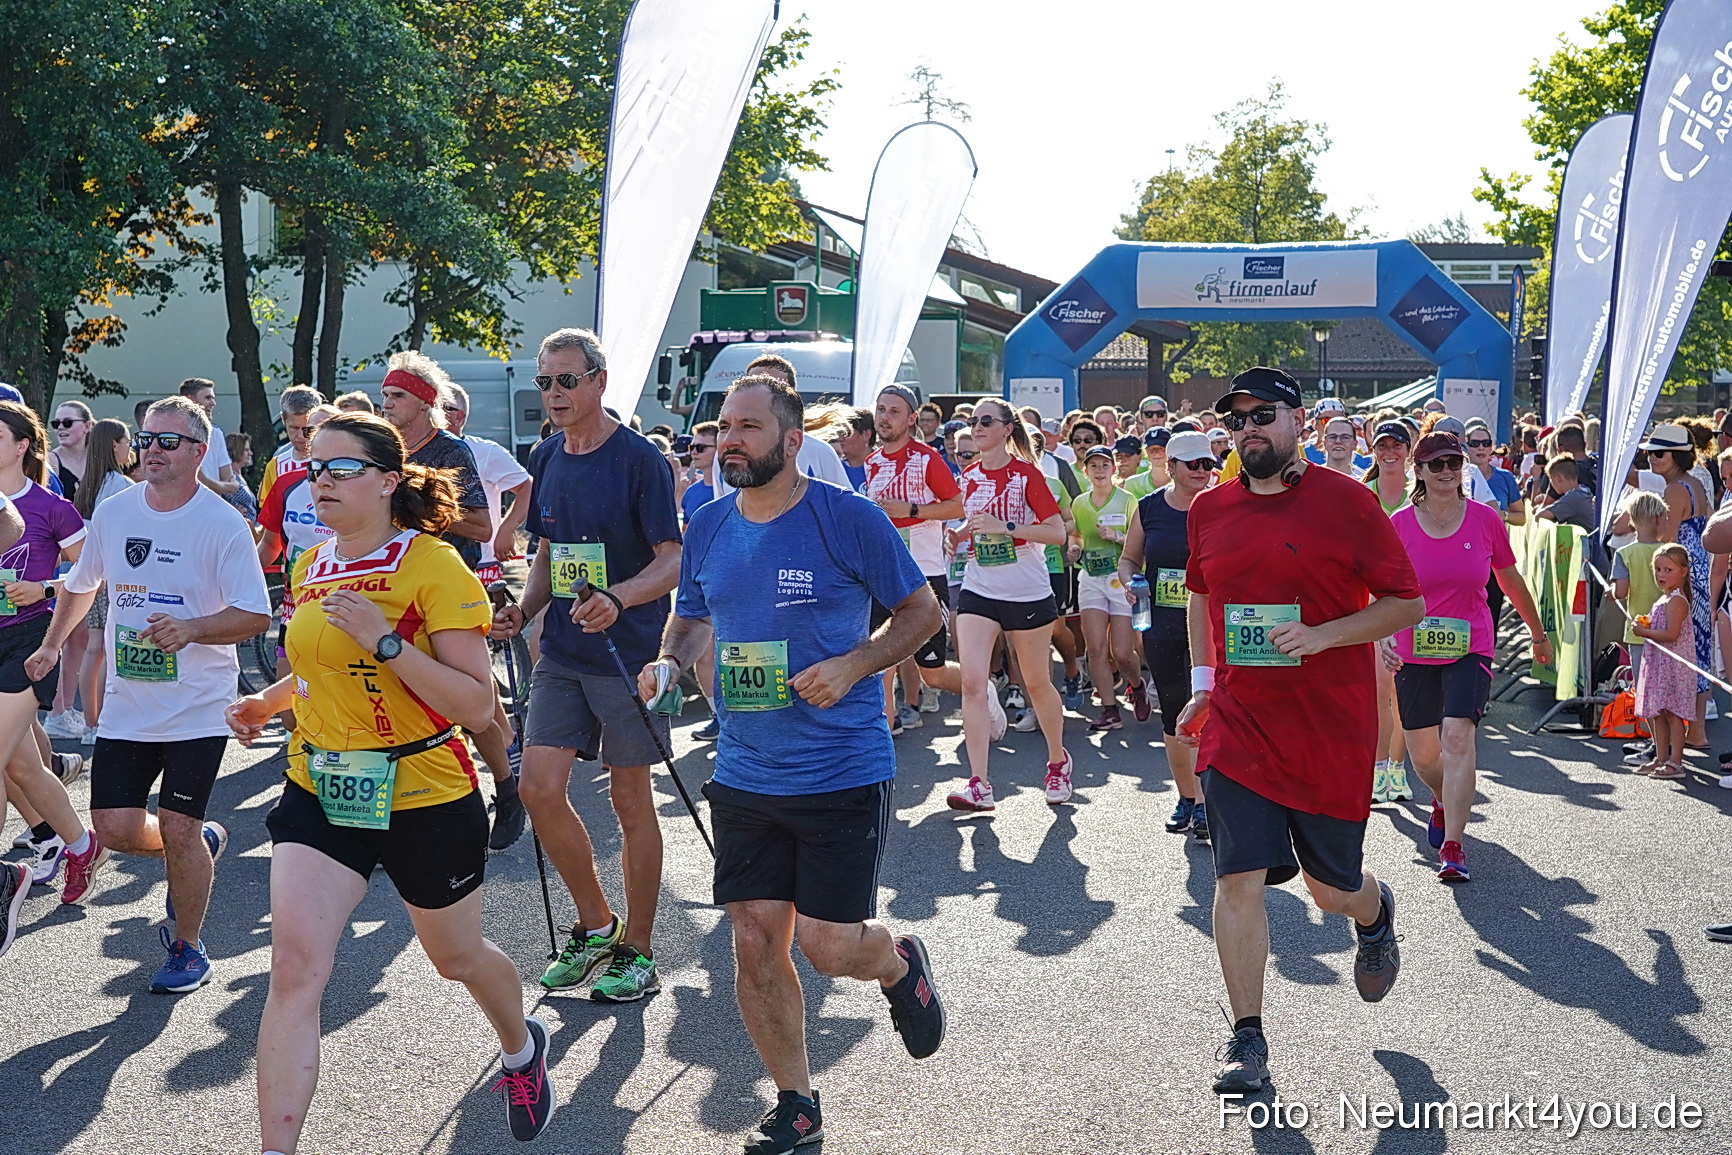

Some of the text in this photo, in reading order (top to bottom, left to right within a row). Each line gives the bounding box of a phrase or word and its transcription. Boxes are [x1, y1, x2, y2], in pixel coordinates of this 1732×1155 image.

[1590, 141, 1629, 243] Fisch
[1229, 279, 1318, 296] firmenlauf
[1057, 307, 1107, 319] Fischer
[1061, 317, 1102, 325] AUTOMOBILE
[154, 547, 181, 557] Autohaus
[978, 542, 1007, 556] 1125
[156, 556, 176, 564] Müller
[1091, 557, 1110, 568] 935
[559, 562, 589, 580] 496
[778, 568, 814, 583] DESS
[115, 584, 147, 594] GLAS
[777, 580, 813, 589] Transporte
[777, 587, 813, 596] Logistik
[116, 592, 146, 611] Götz
[1426, 630, 1456, 646] 899
[122, 645, 165, 666] 1226
[1238, 647, 1258, 655] Ferstl
[728, 666, 766, 689] 140
[774, 668, 787, 700] 2022
[741, 690, 769, 699] Markus
[317, 772, 375, 803] 1589
[173, 791, 193, 801] benger
[375, 783, 389, 818] 2022
[321, 800, 372, 814] rost Marketa
